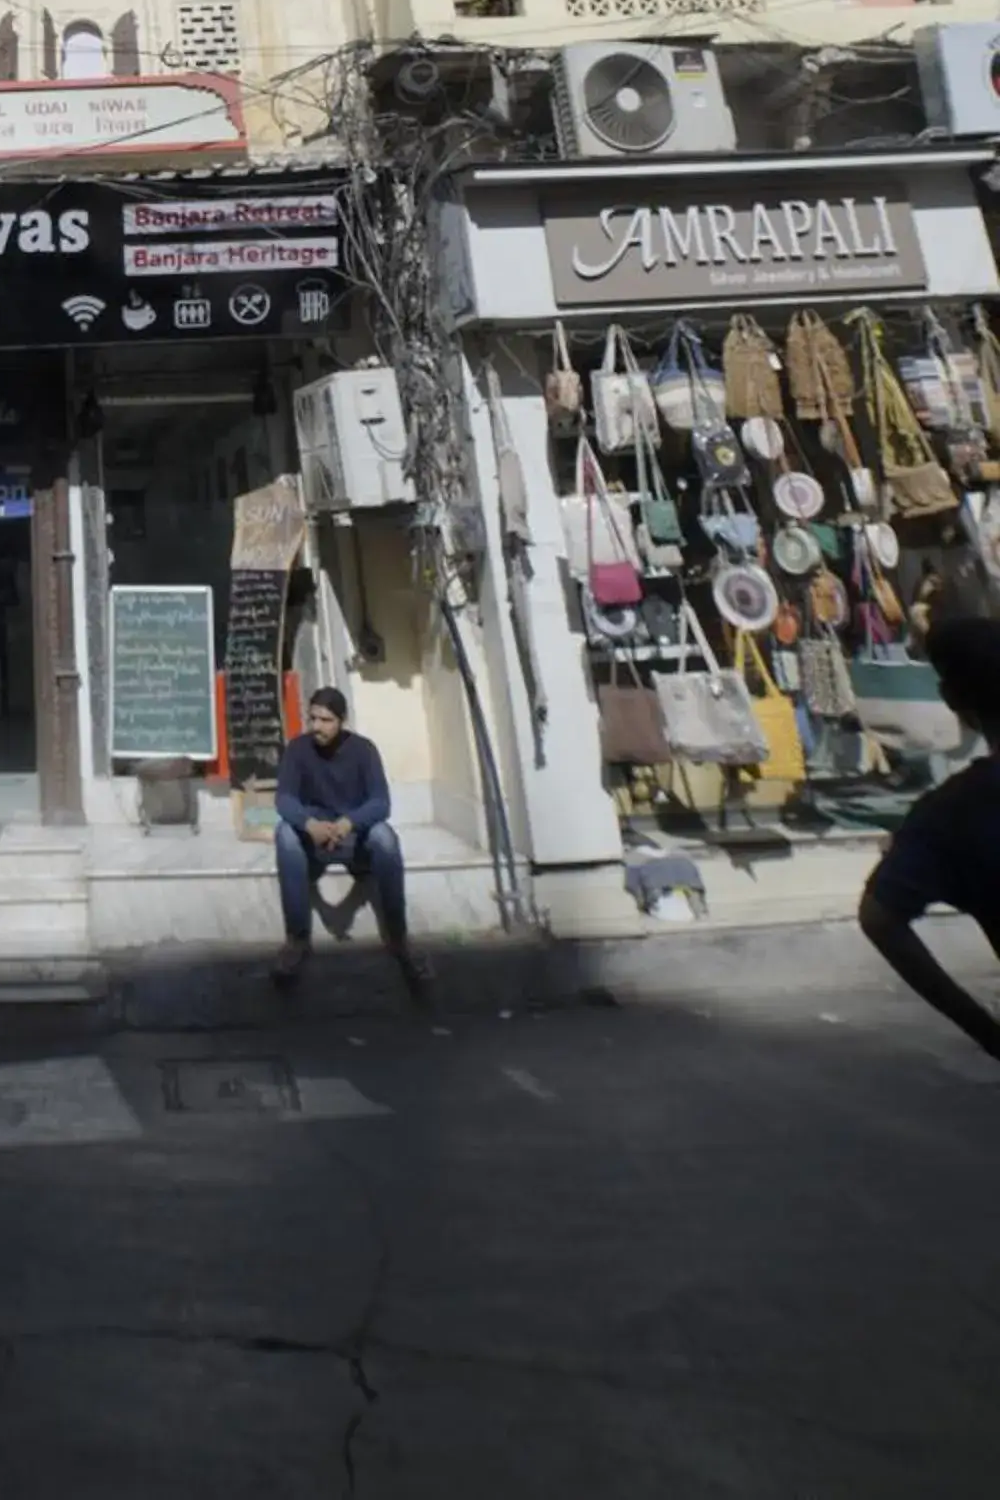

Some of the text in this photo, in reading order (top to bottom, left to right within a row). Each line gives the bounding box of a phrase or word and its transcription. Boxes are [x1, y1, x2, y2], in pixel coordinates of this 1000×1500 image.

[24, 101, 68, 115] UDAI
[88, 98, 148, 113] NIWAS
[135, 202, 324, 228] Banjara Retreat
[572, 196, 898, 280] AMRAPALI
[134, 244, 329, 271] Banjara Heritage
